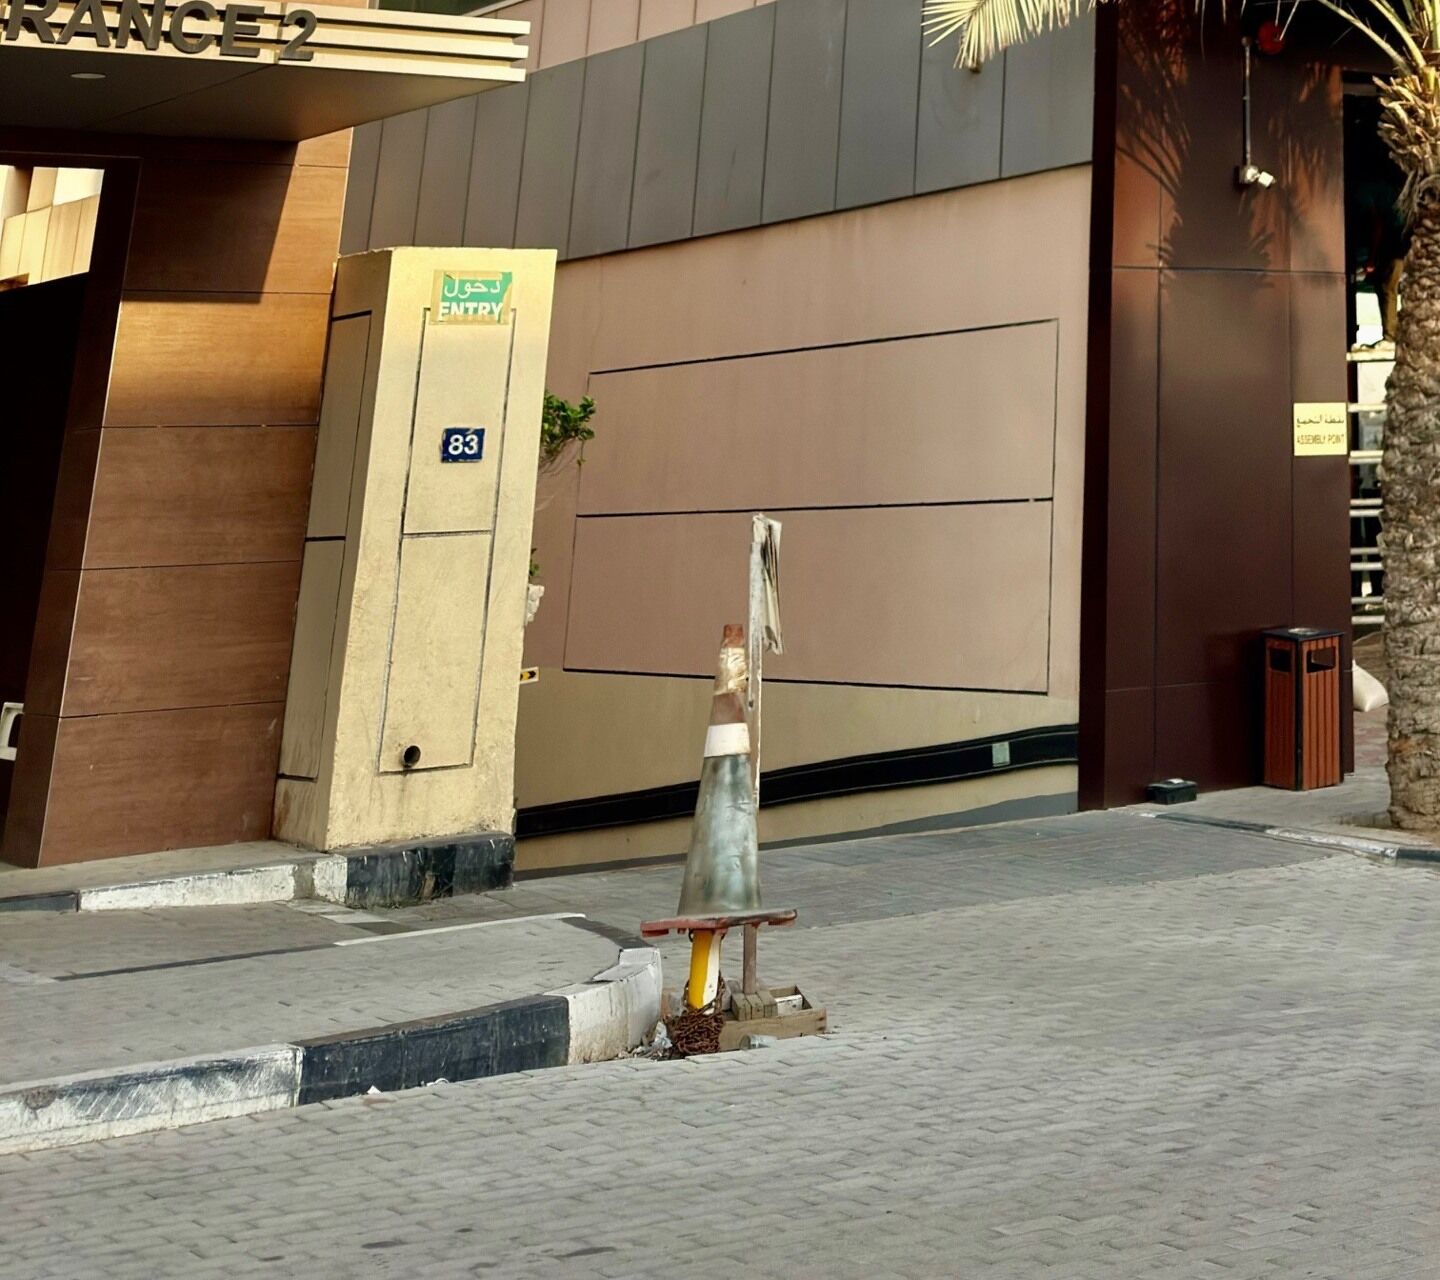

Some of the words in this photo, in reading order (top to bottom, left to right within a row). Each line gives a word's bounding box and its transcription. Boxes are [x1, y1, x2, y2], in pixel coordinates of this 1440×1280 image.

[279, 8, 318, 62] 2
[444, 277, 501, 299] دخول
[438, 301, 503, 321] ENTRY
[448, 434, 478, 455] 83
